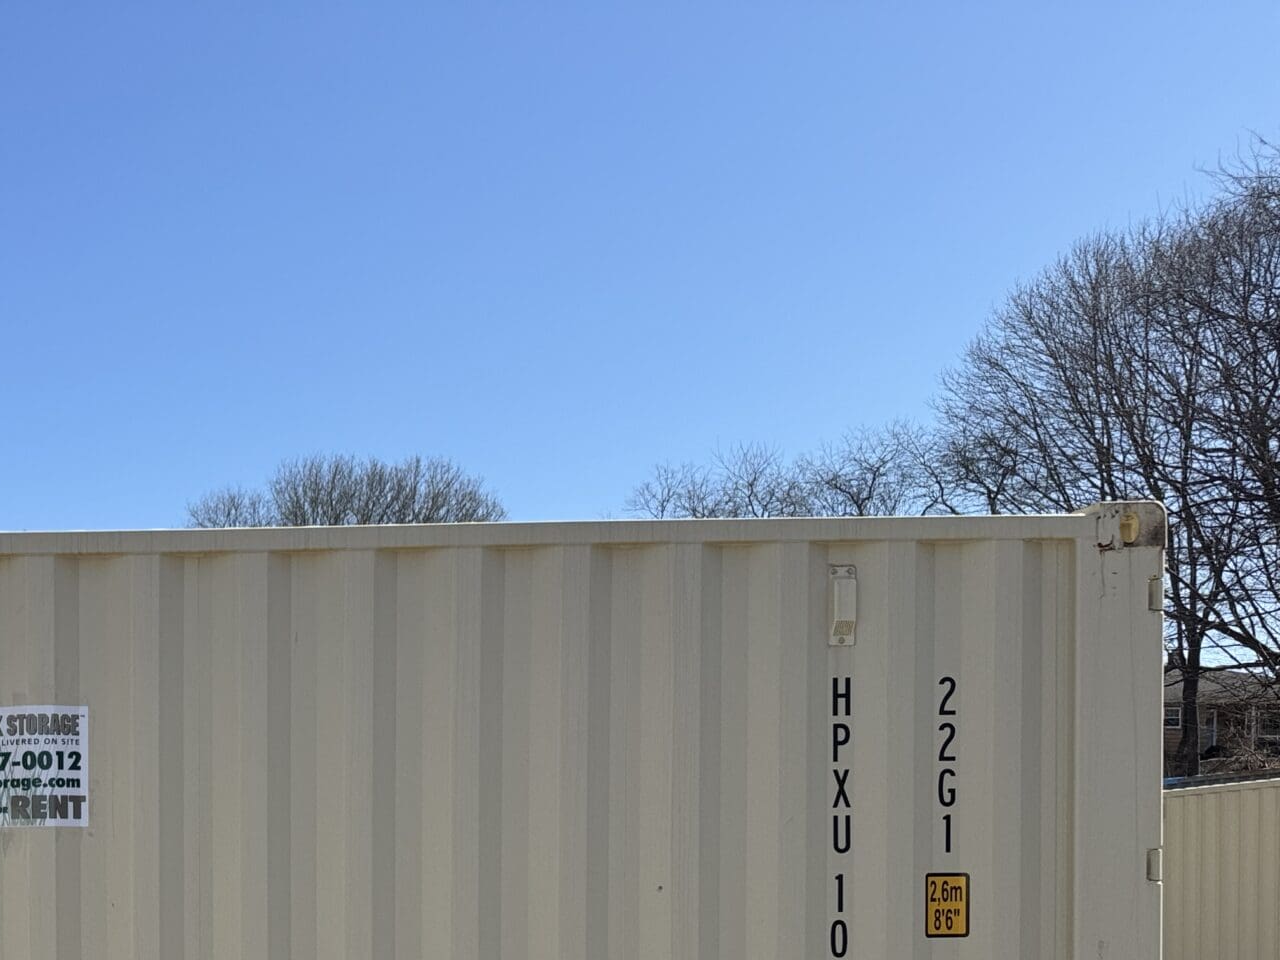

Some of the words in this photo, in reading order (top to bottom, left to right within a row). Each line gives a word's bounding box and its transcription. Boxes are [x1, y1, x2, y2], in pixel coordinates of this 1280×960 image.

[6, 713, 80, 736] STORAGE
[61, 738, 80, 746] SITE
[832, 676, 852, 854] HPXU
[937, 676, 957, 853] 22G1
[11, 795, 86, 819] RENT
[930, 880, 962, 906] 2,6m
[934, 908, 960, 931] 8'6"
